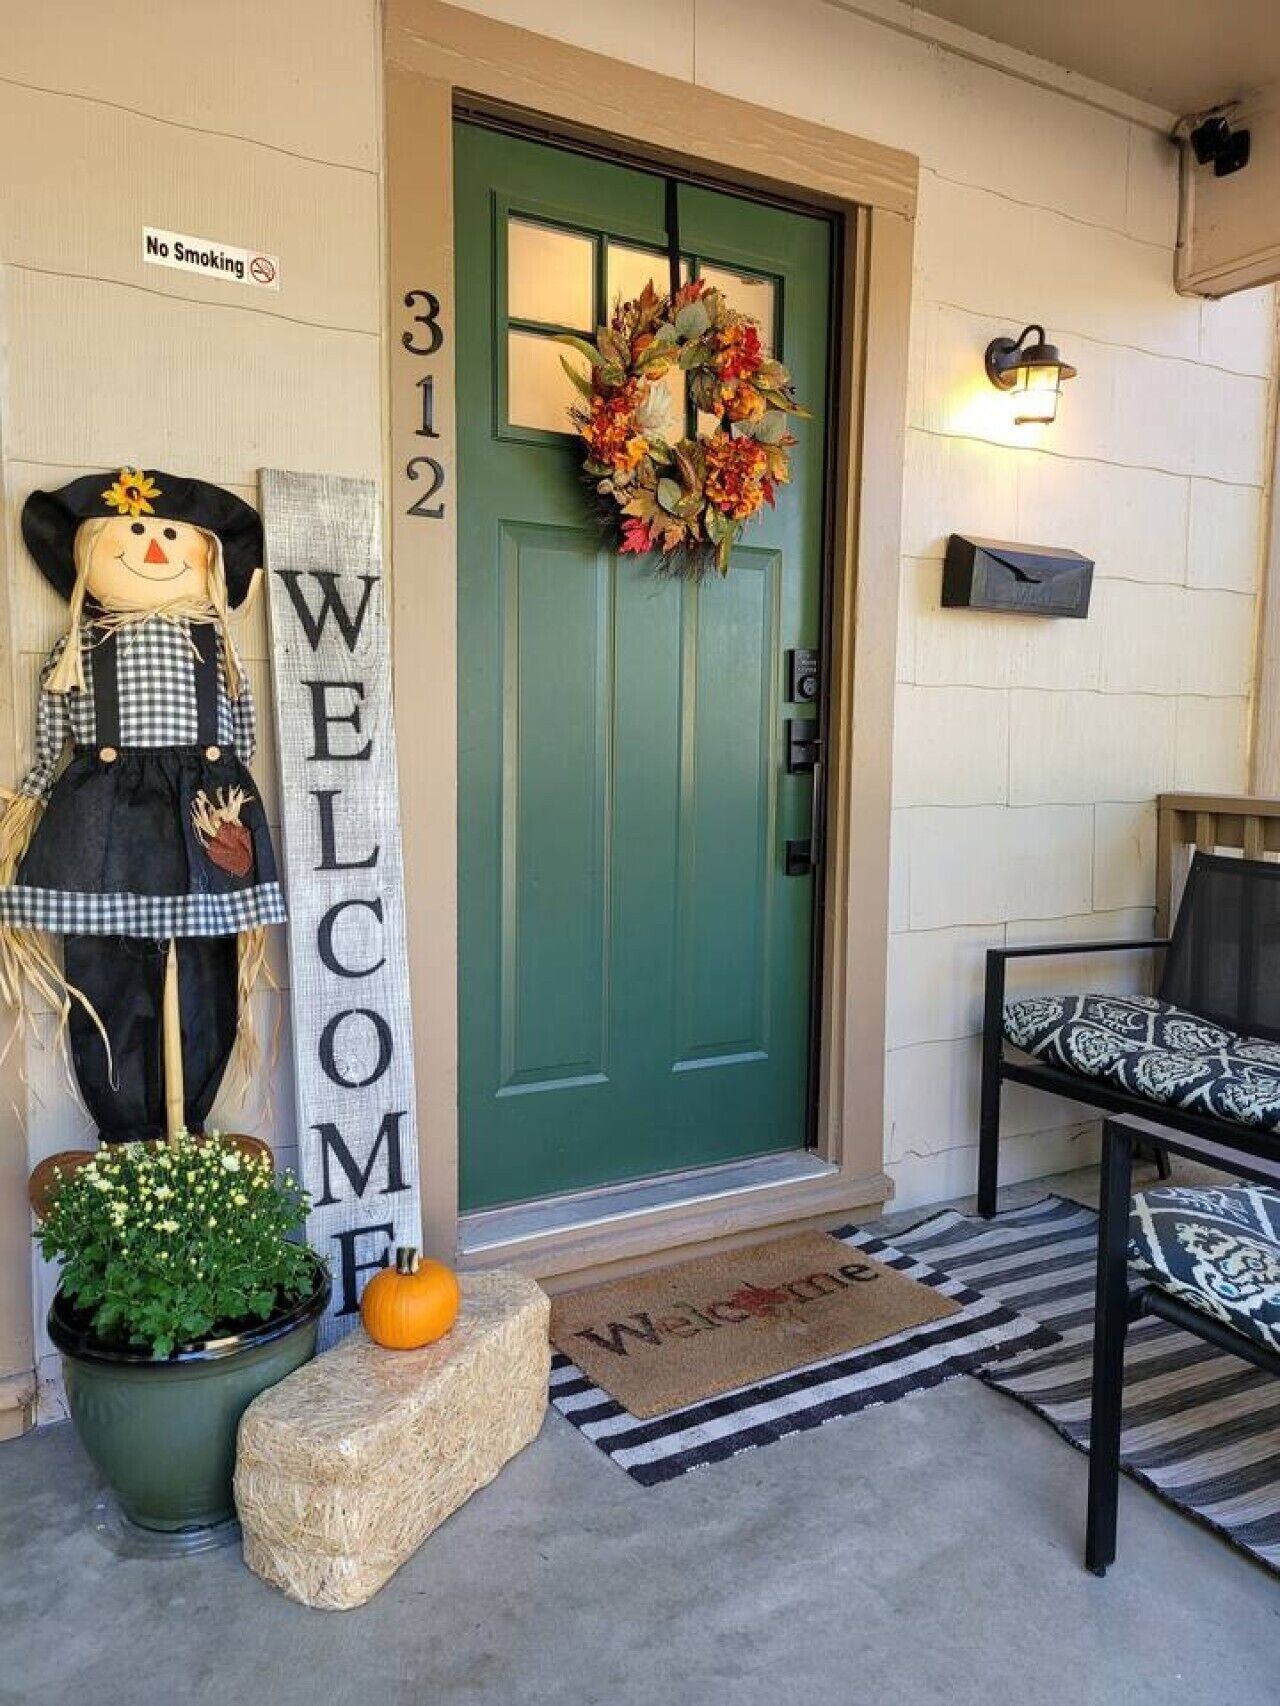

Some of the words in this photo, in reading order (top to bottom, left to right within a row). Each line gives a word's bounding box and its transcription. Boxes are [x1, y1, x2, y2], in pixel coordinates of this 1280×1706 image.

[146, 235, 169, 257] No
[174, 241, 245, 280] Smoking
[402, 289, 444, 519] 312
[574, 1262, 880, 1357] Welcme
